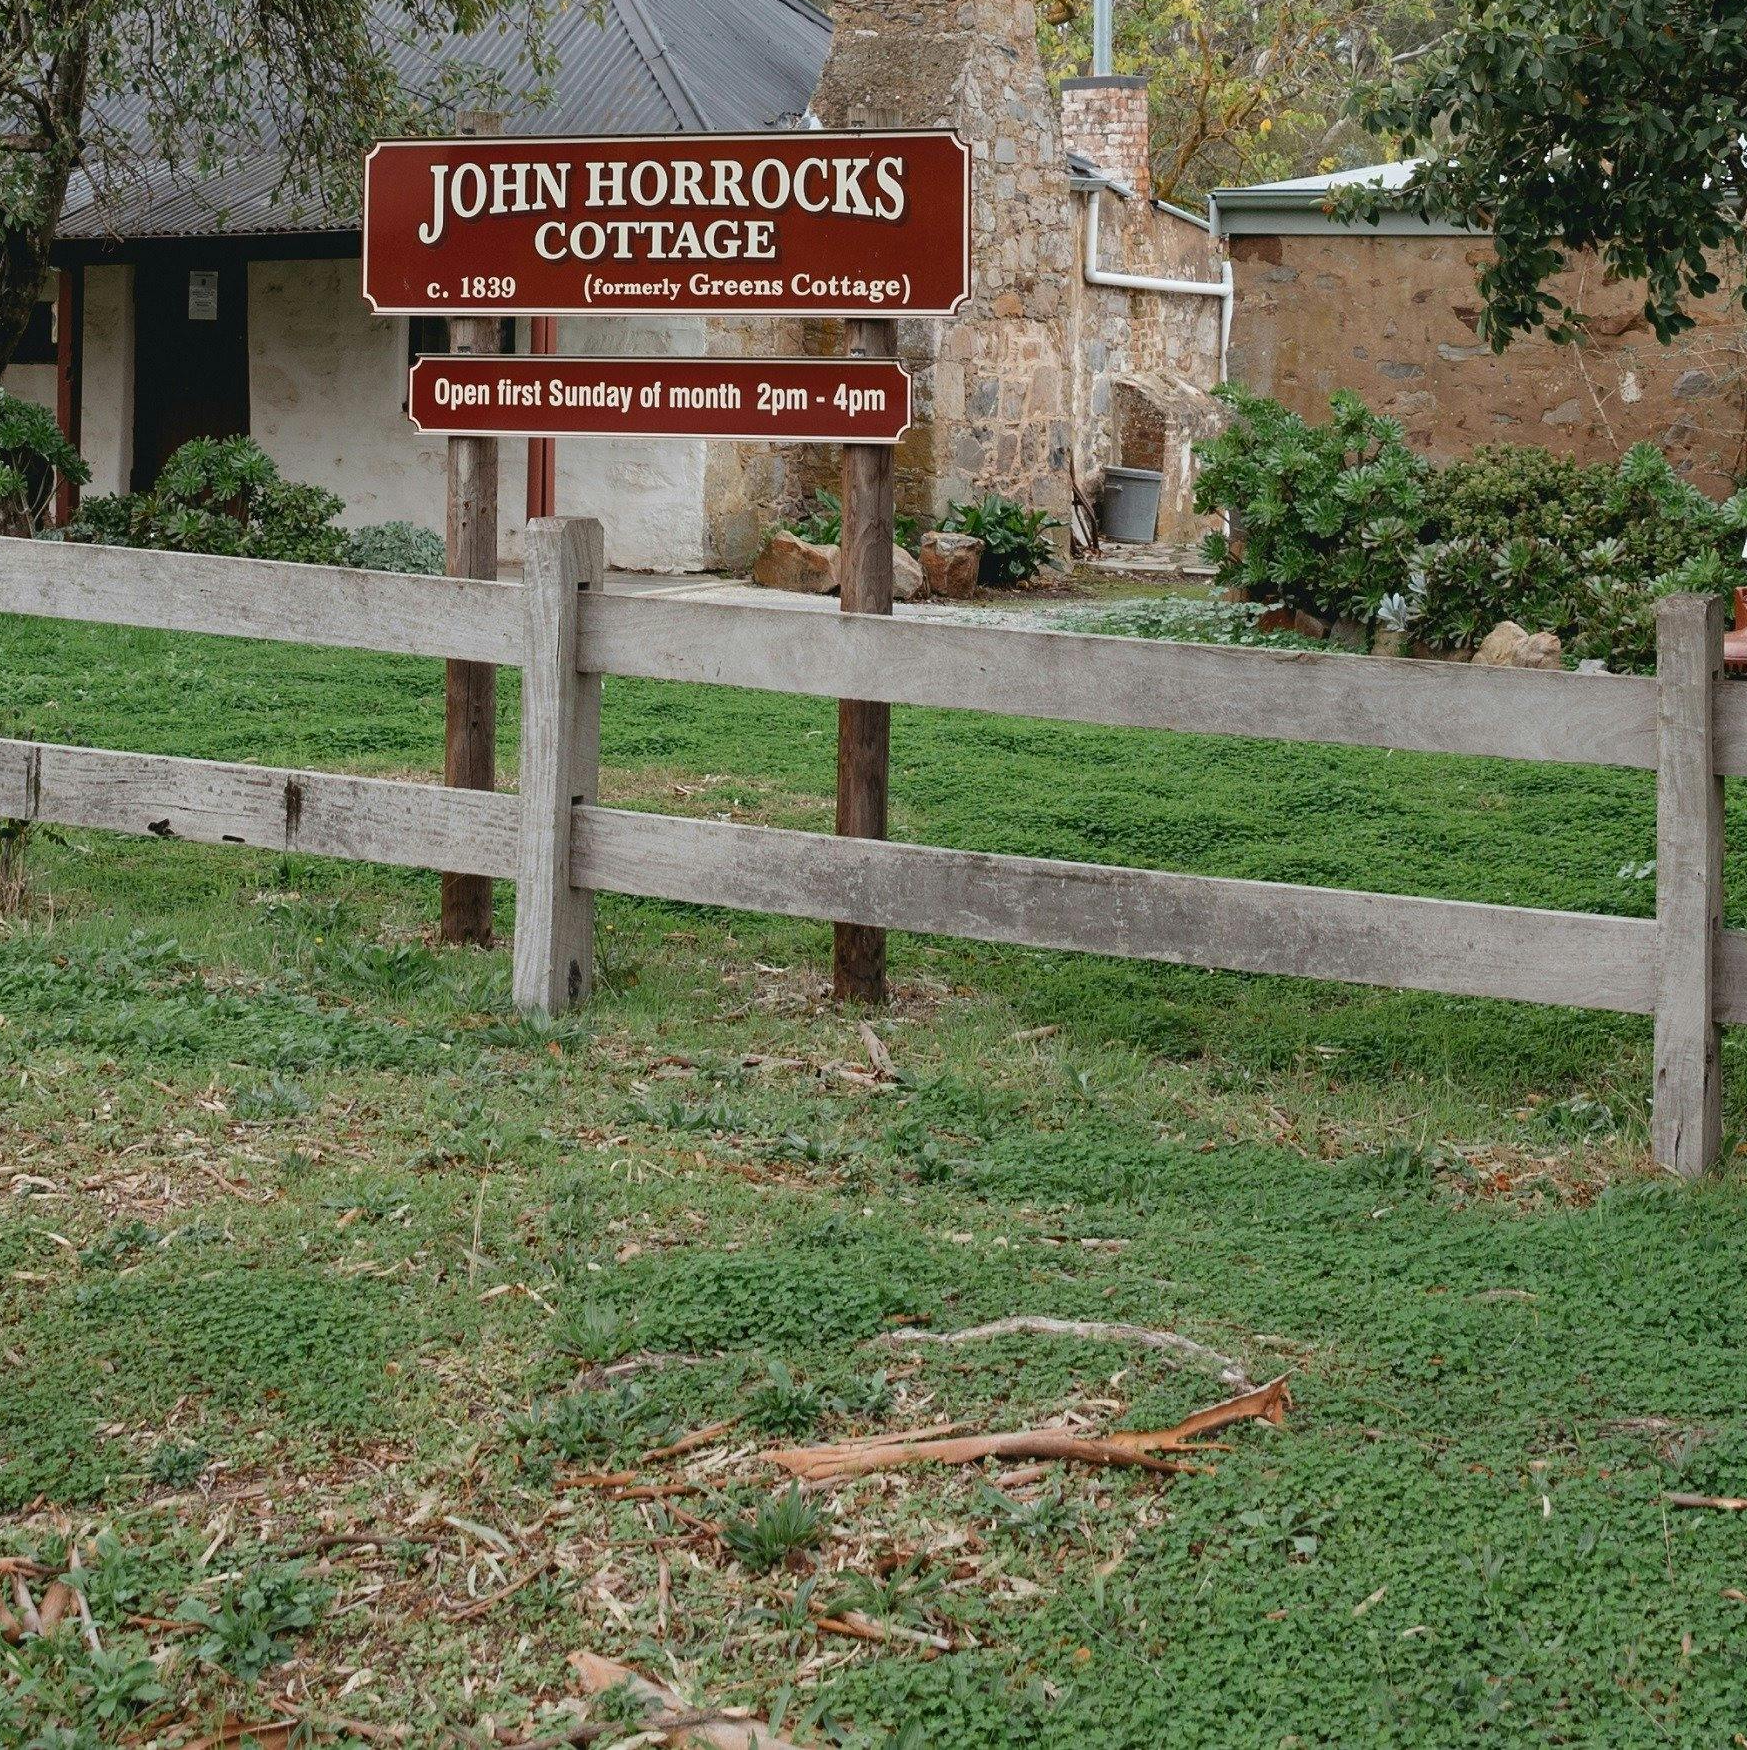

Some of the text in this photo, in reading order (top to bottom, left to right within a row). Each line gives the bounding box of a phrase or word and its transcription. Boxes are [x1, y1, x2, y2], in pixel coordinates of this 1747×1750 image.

[418, 156, 905, 245] JOHN HORROCKS
[534, 219, 776, 260] COTTAGE
[426, 273, 911, 305] c. 1839 (formerly Greens Cottage)
[434, 377, 490, 411] Open
[496, 378, 542, 406] first
[548, 378, 634, 414] Sunday
[639, 380, 662, 408] of
[669, 380, 741, 409] month
[756, 382, 808, 416] 2pm
[832, 383, 886, 418] 4pm
